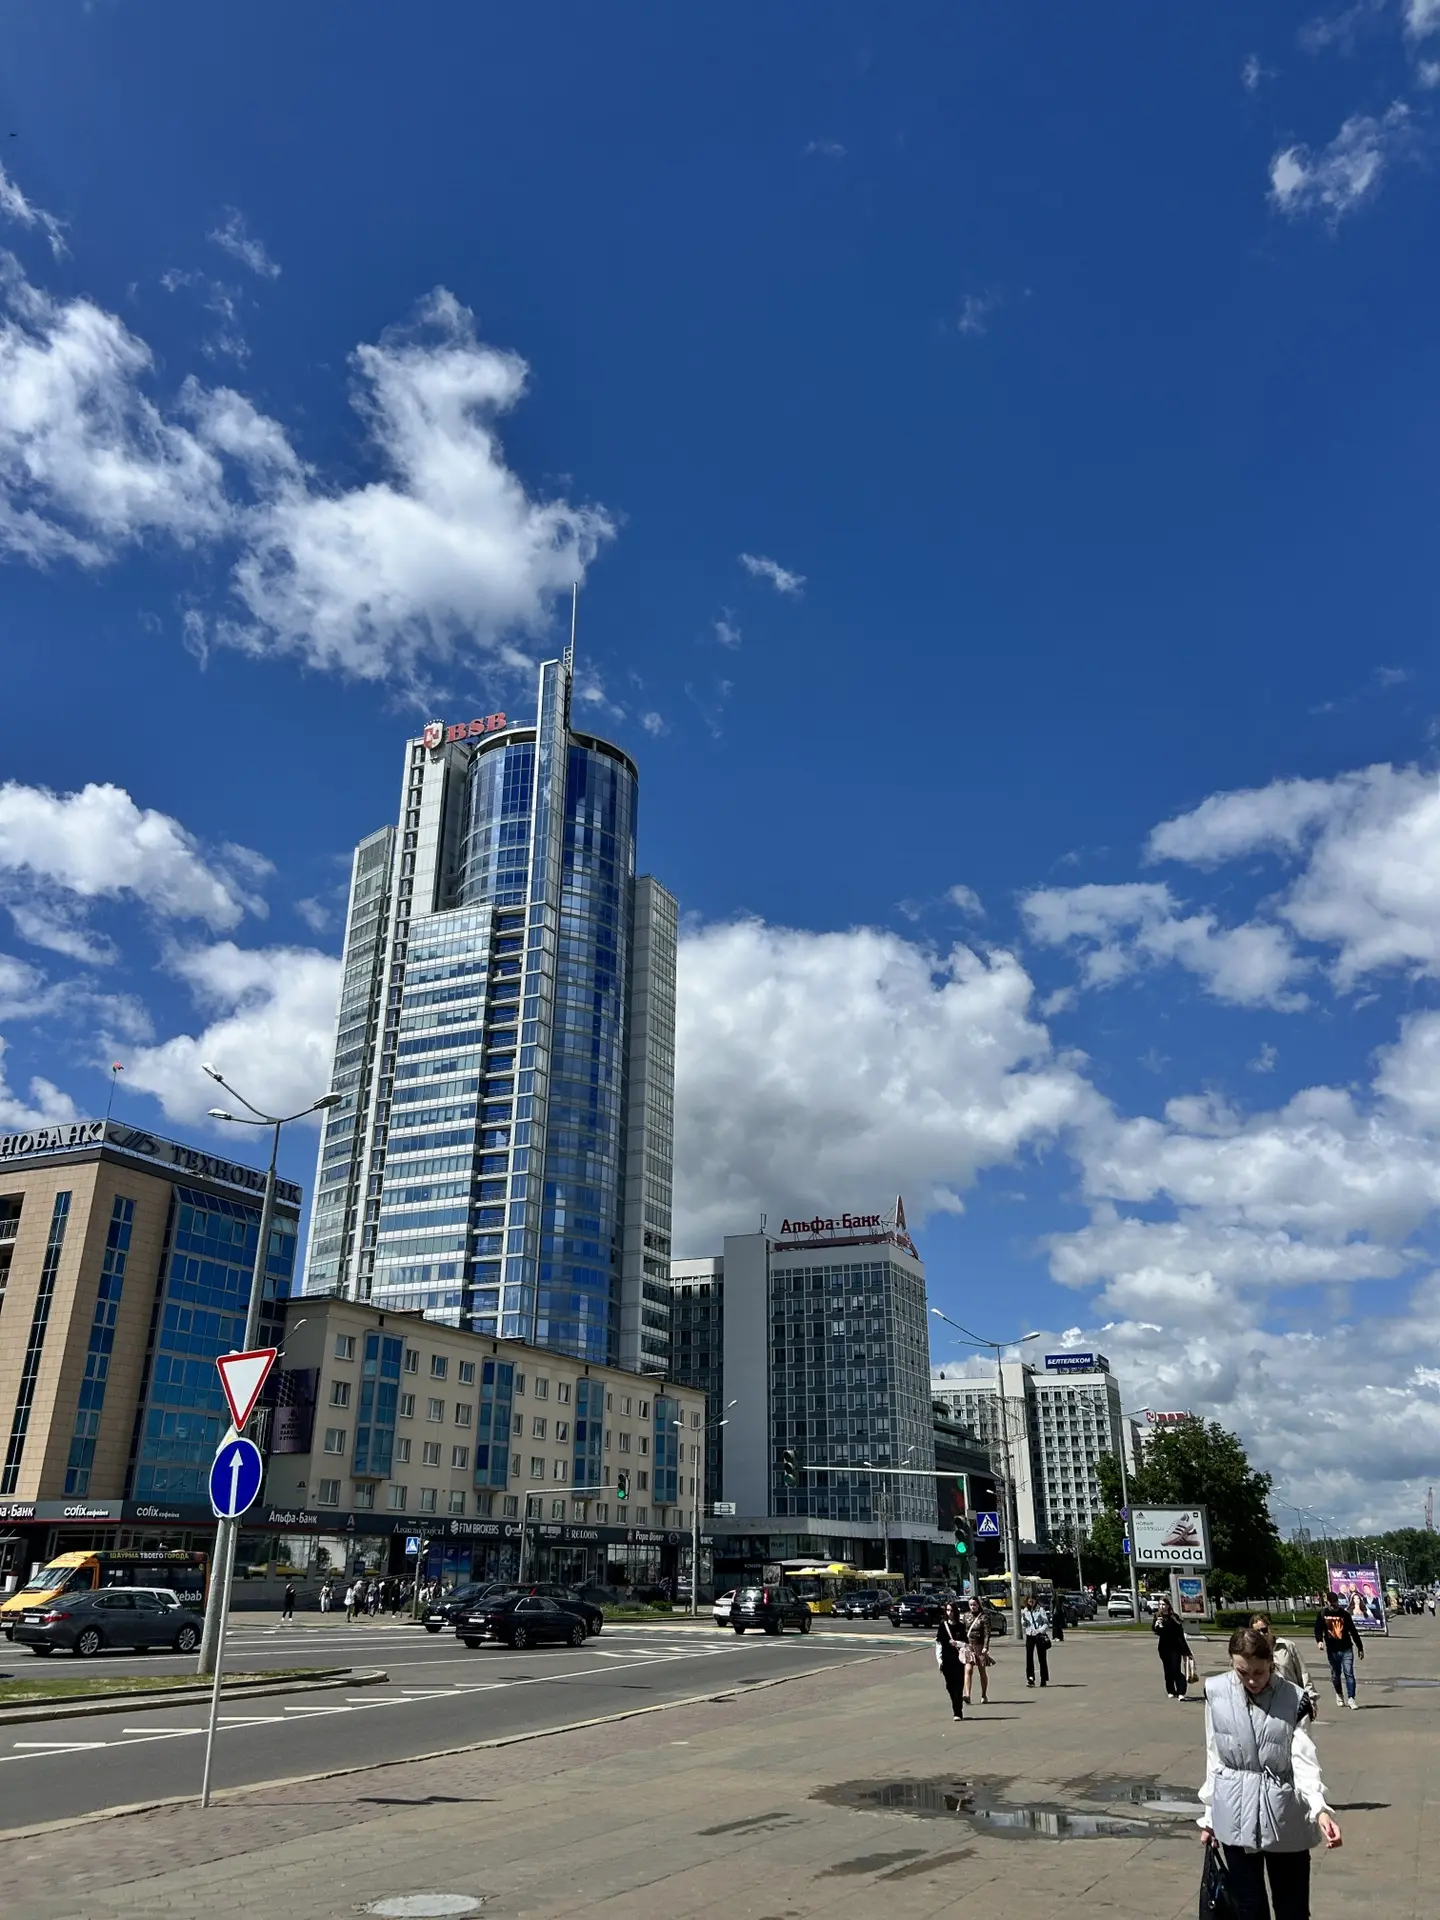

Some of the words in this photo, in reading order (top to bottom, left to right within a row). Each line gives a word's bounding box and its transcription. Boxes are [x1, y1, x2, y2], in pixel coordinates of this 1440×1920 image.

[446, 712, 507, 743] BSB
[1047, 1357, 1092, 1365] БЕЛТЕЛЕКОМ
[64, 1504, 87, 1517] cofix
[136, 1505, 159, 1517] cofix
[473, 1524, 500, 1535] BROKERS
[164, 1552, 190, 1560] ГОРОДА
[1138, 1547, 1204, 1560] lamoda
